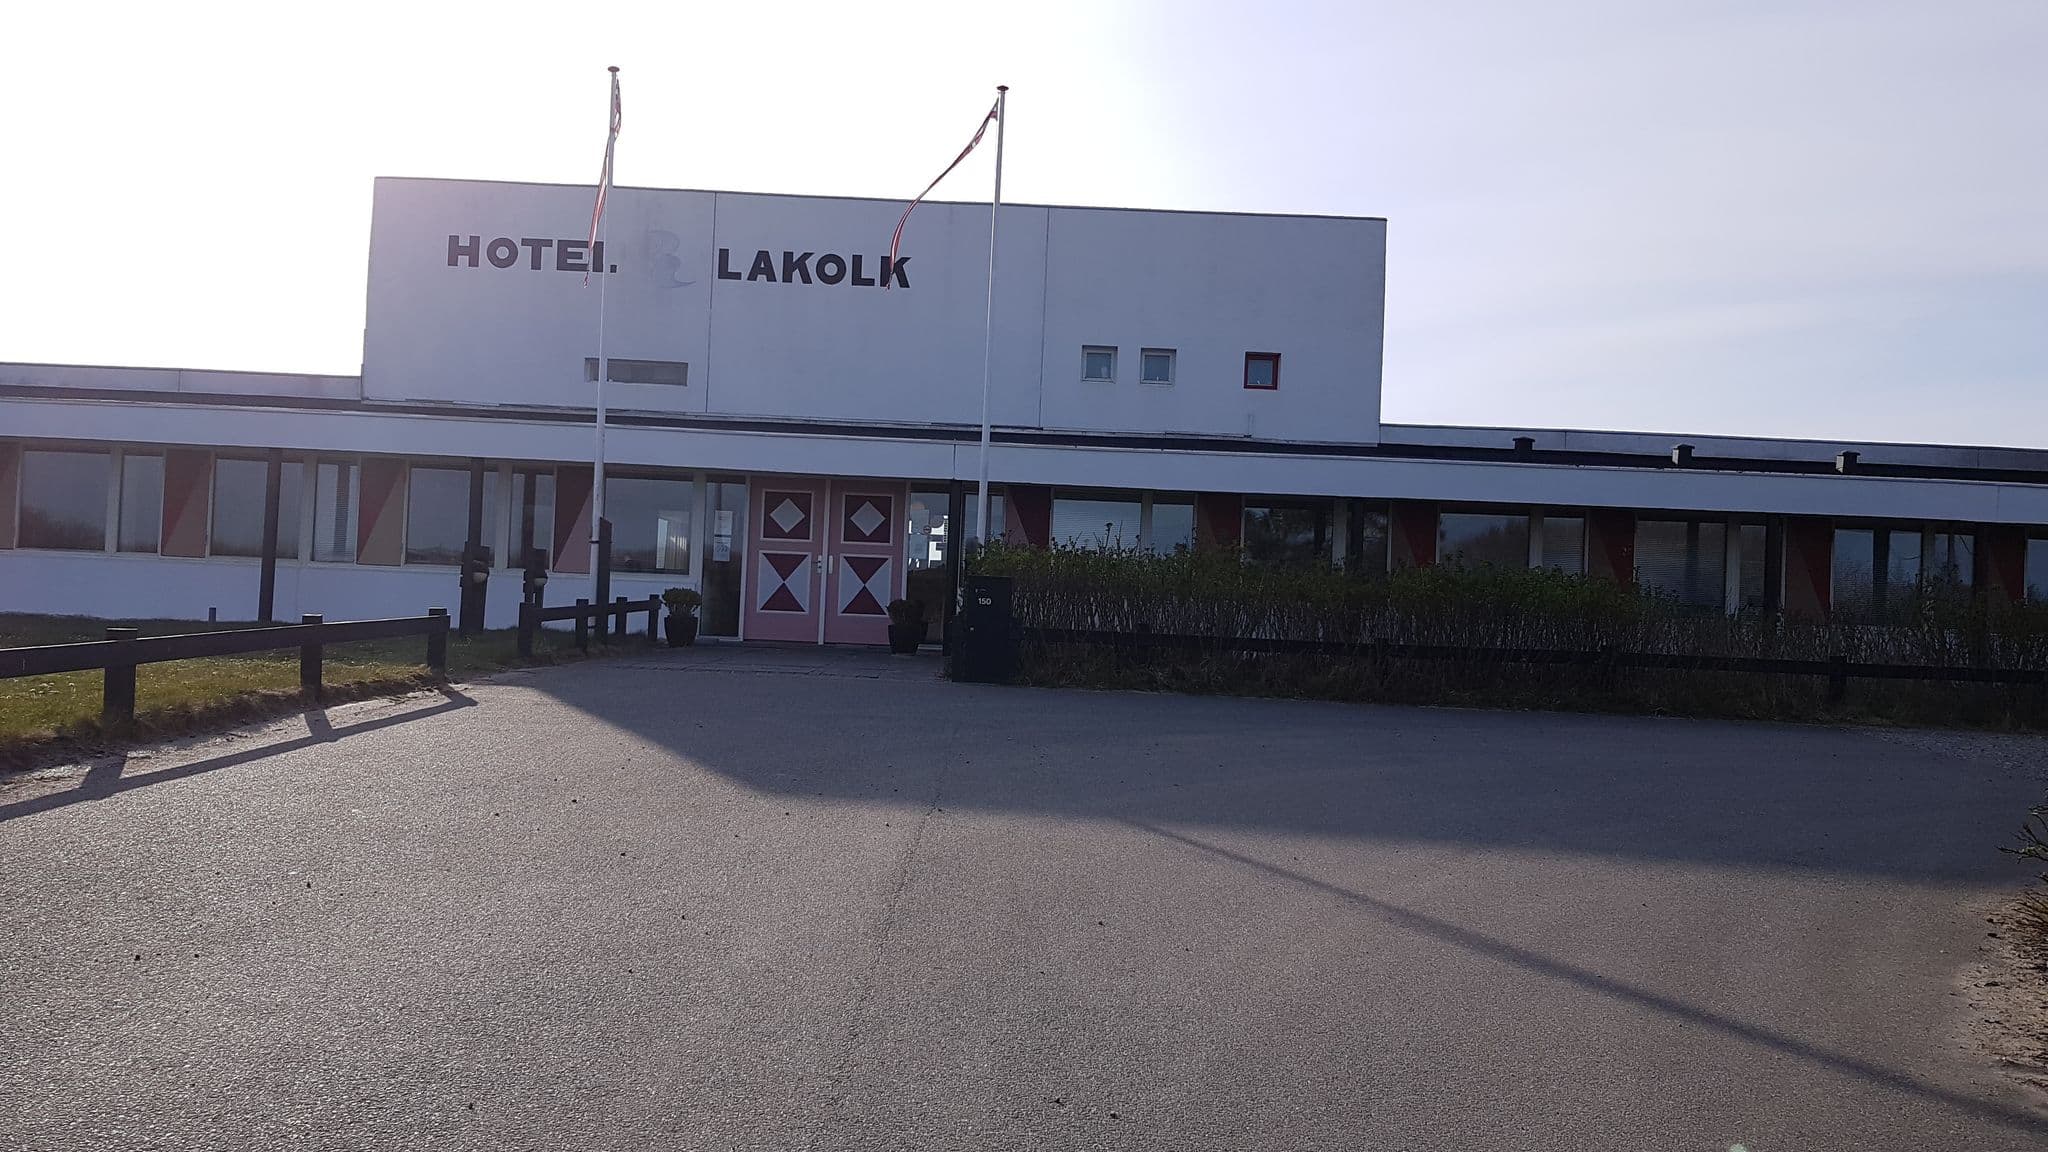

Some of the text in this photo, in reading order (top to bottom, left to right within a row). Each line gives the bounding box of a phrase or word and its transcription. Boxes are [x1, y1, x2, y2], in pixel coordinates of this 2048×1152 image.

[447, 235, 618, 273] HOTEL
[718, 248, 912, 288] LAKOLK
[978, 597, 992, 606] 150
